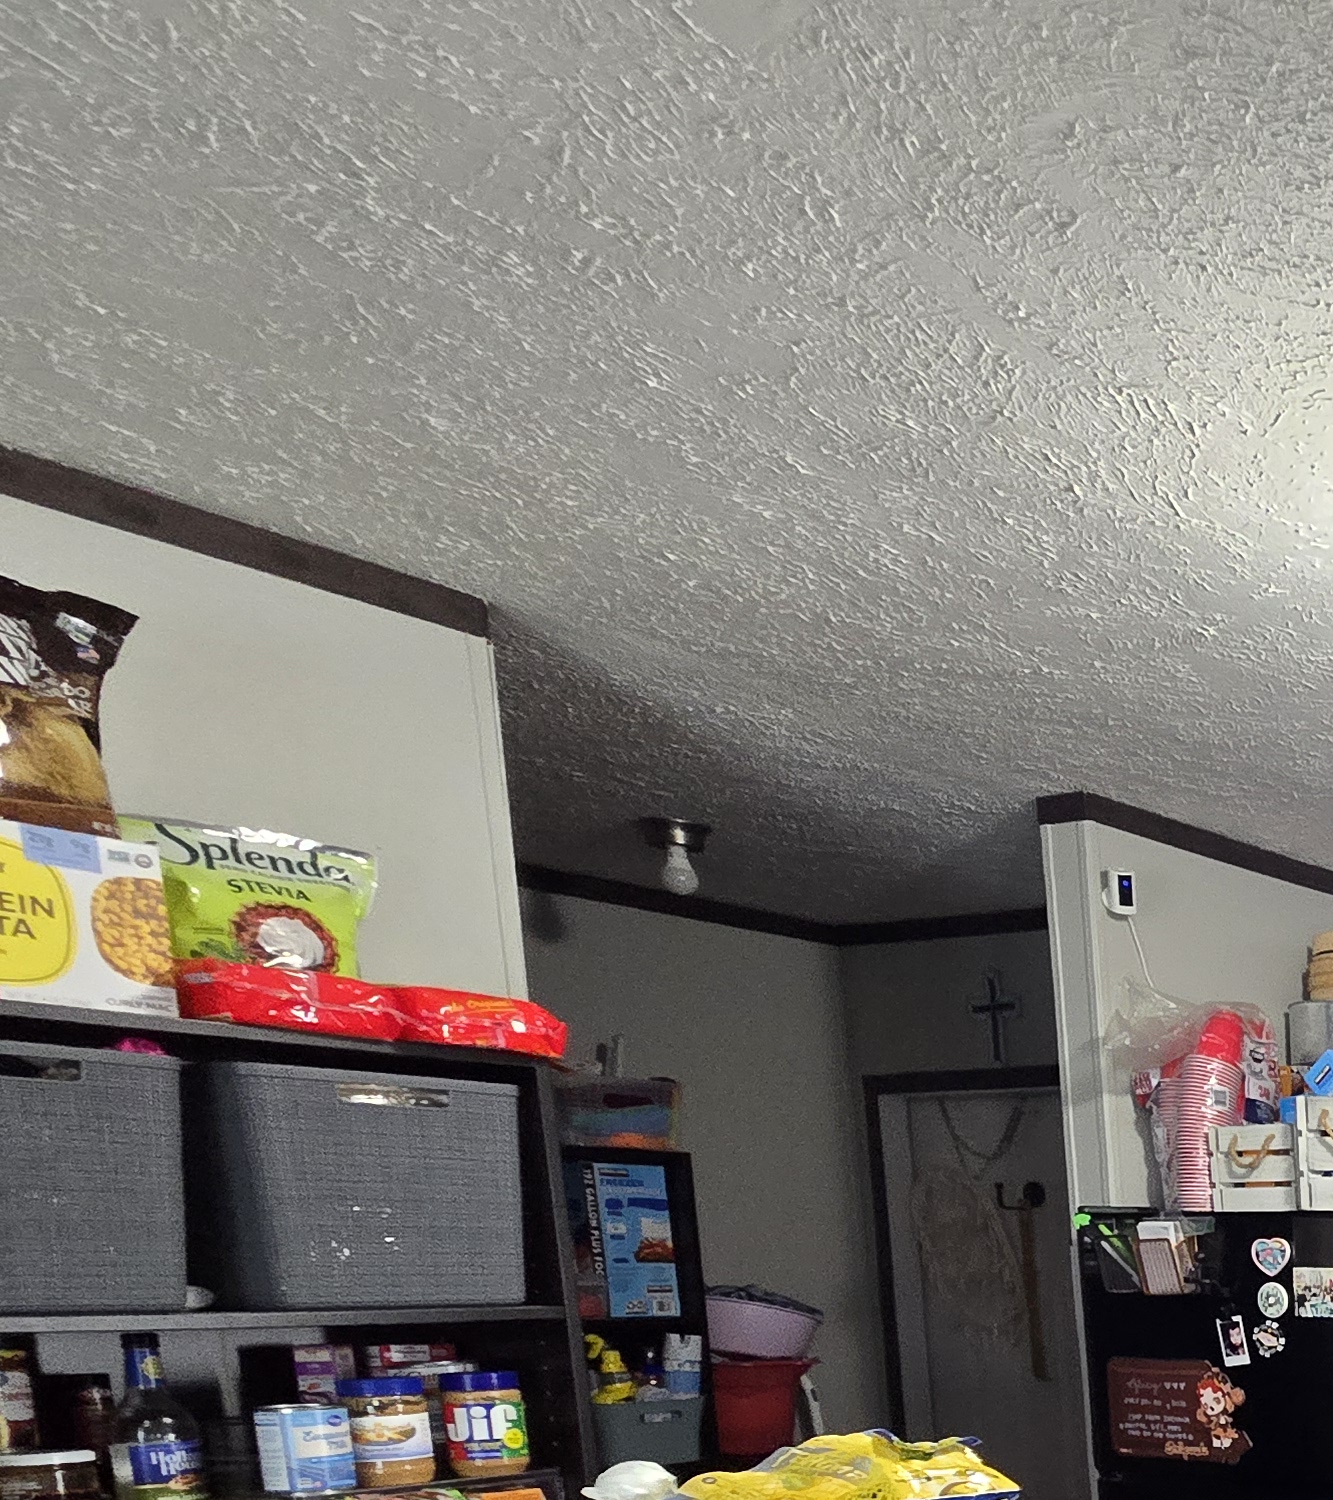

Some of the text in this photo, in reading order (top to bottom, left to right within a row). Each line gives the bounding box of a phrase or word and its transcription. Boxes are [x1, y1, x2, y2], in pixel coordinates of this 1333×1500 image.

[154, 822, 355, 884] Splenda
[227, 878, 312, 902] STEVIA
[447, 1401, 517, 1442] Jif
